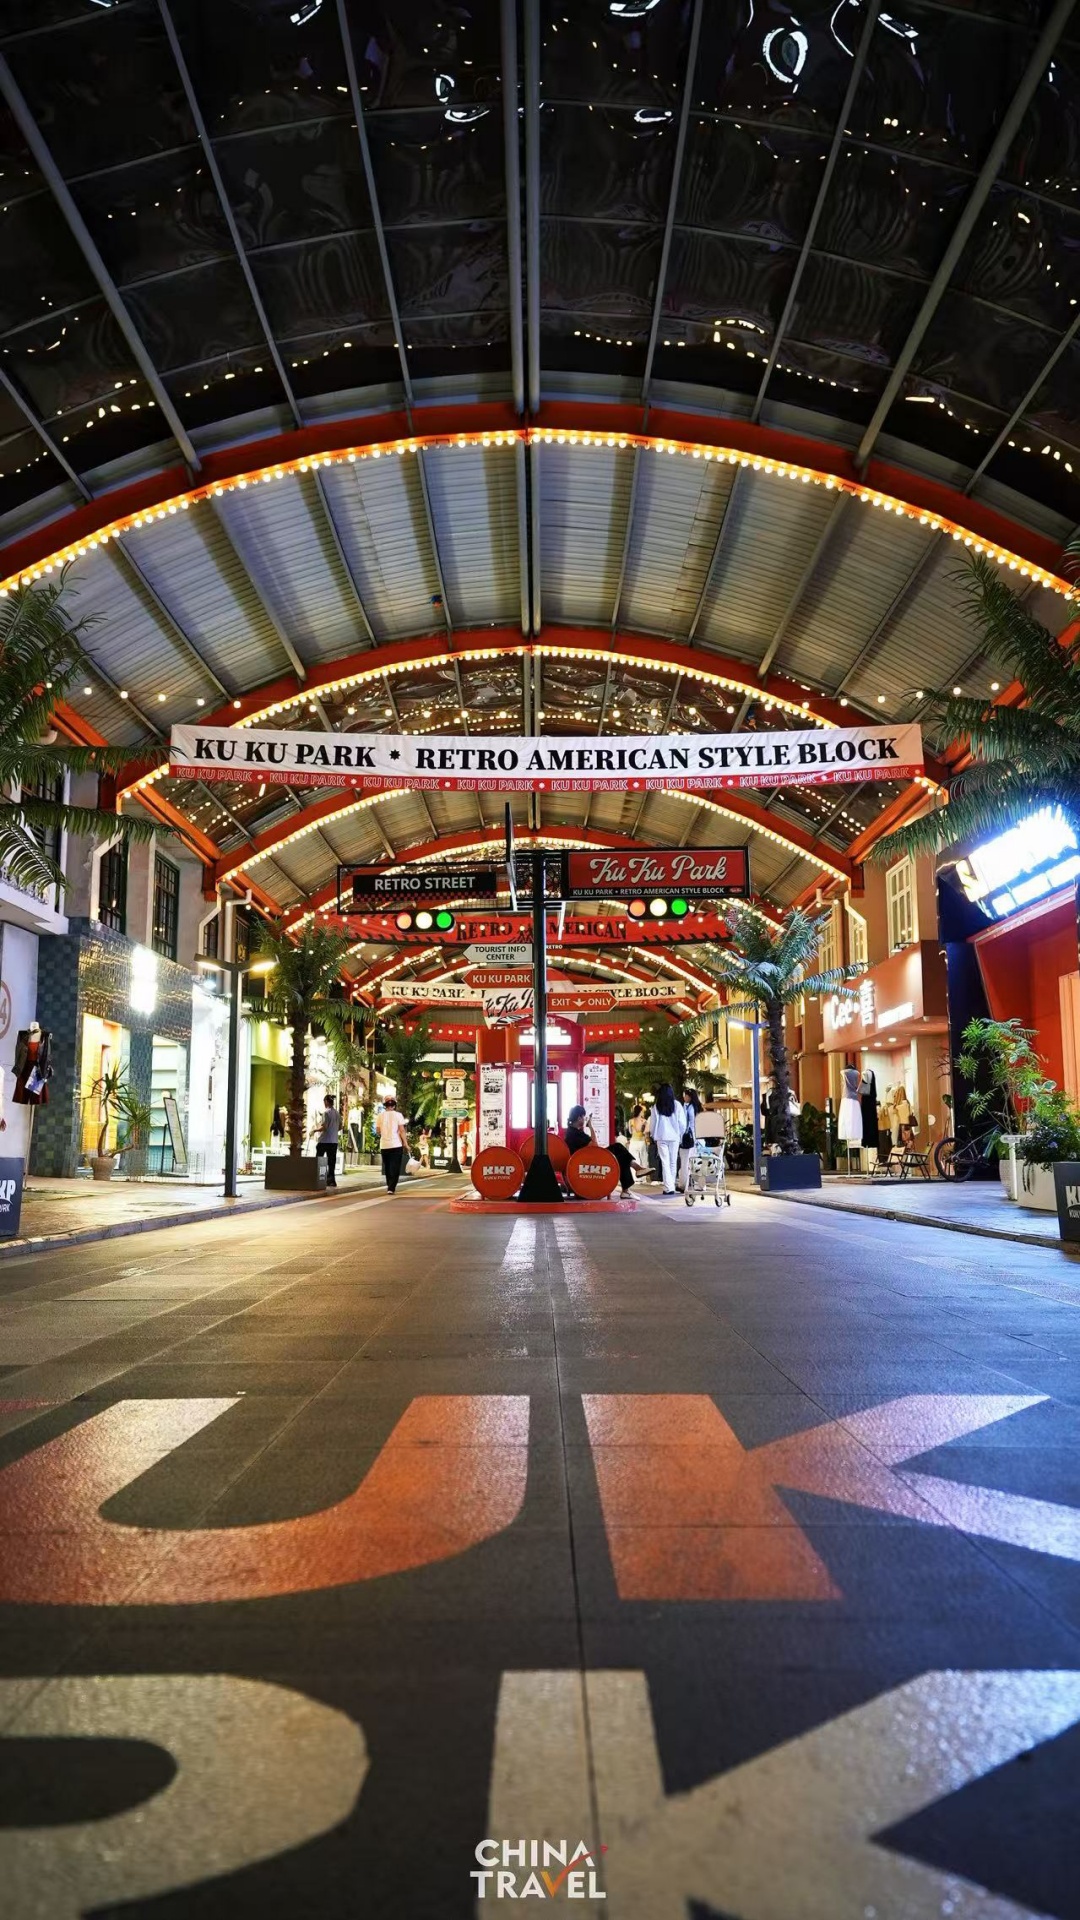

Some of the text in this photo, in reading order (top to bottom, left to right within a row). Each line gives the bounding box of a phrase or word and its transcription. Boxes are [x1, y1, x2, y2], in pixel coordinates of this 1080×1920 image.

[194, 737, 899, 771] KU KU PARK RETRO AMERICAN STYLE BLOCK
[176, 767, 911, 791] KU KU PARK KU KU PARK KU KU PARK KU KU PARK KU KU PARK KU KU PARK KU KU PARK KU KU PARK
[589, 854, 728, 884] Ku Ku Park
[374, 876, 476, 891] RETRO STREET
[573, 888, 583, 896] KU
[584, 888, 594, 896] KU
[643, 887, 680, 895] AMERICAN
[456, 920, 627, 941] RETRO MERICAN
[472, 974, 531, 983] KU KU PARK
[551, 998, 571, 1006] EXIT
[587, 998, 612, 1006] ONLY
[482, 1165, 516, 1176] KKP
[578, 1164, 611, 1175] KKP
